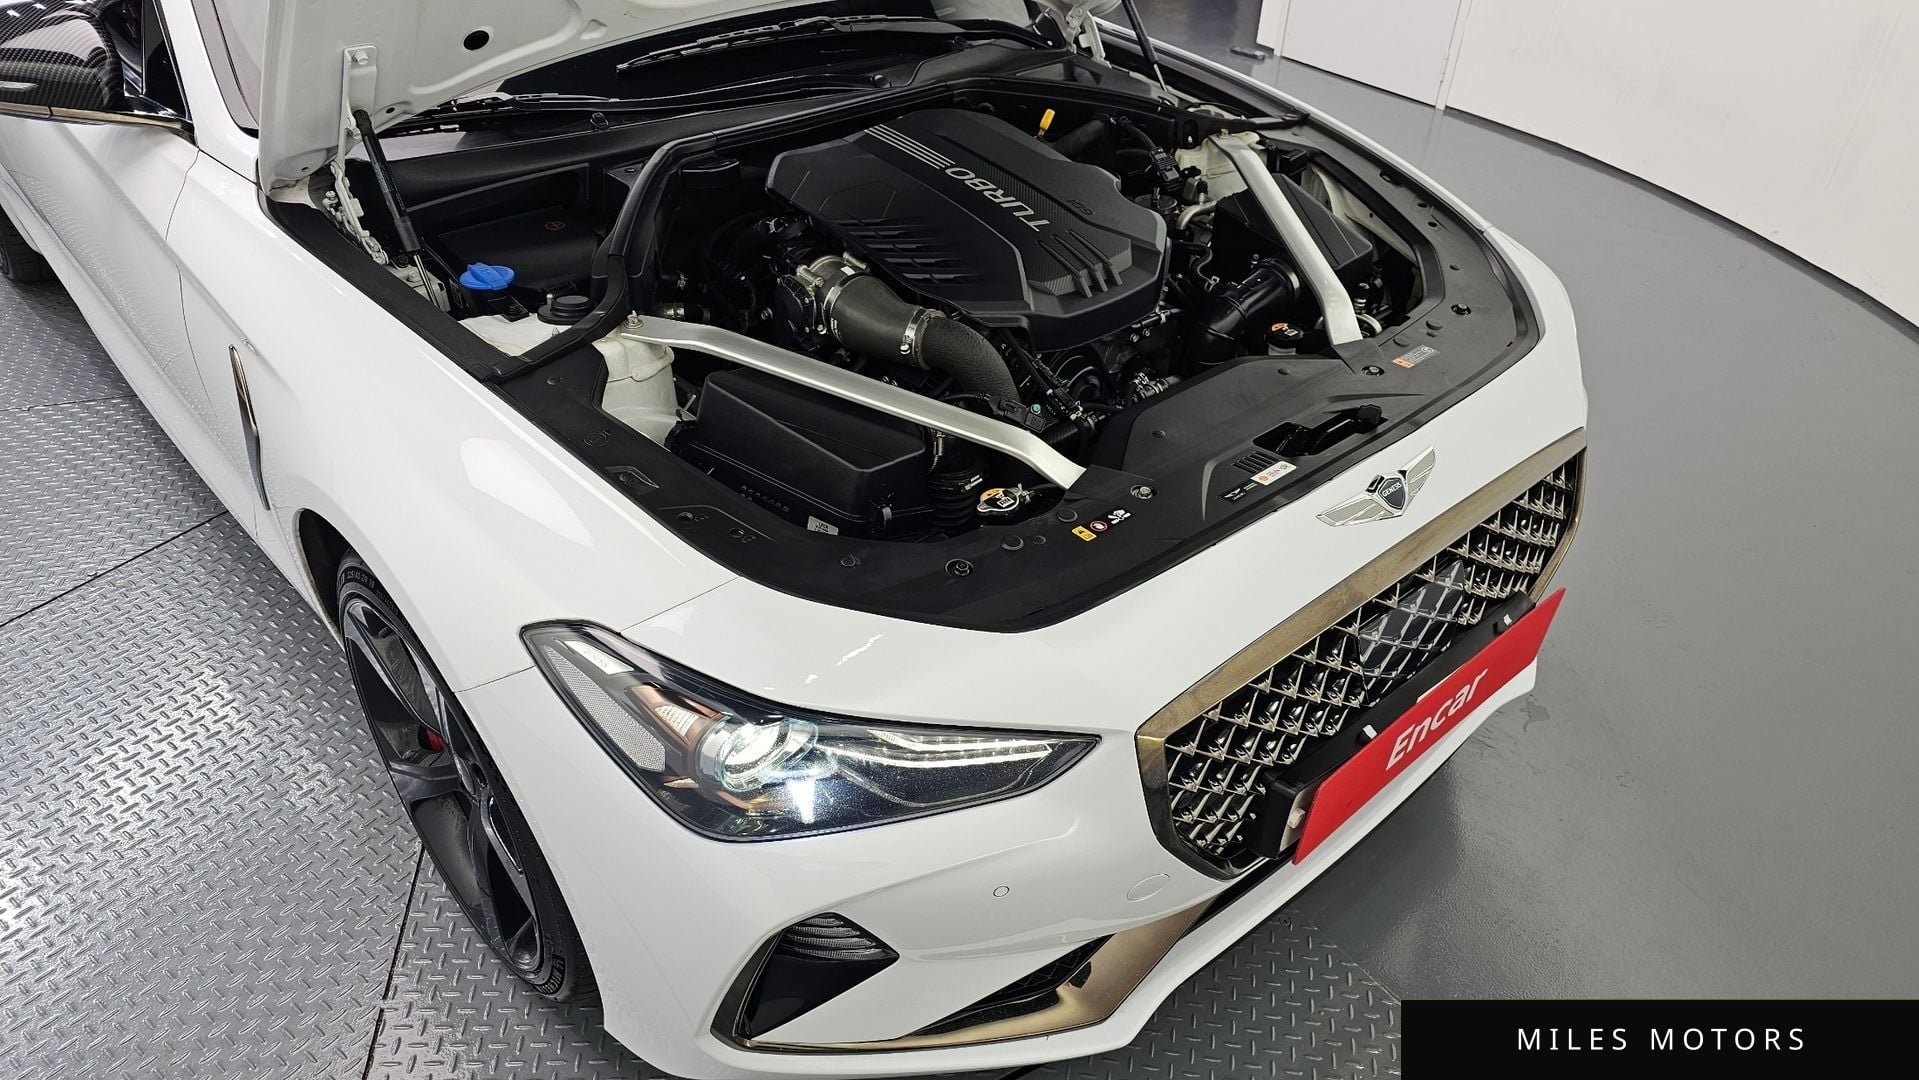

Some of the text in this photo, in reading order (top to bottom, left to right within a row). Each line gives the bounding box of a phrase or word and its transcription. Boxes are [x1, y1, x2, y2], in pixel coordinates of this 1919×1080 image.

[945, 167, 1050, 232] TURBO
[1381, 481, 1402, 497] GENESIS
[1386, 668, 1488, 771] Encar
